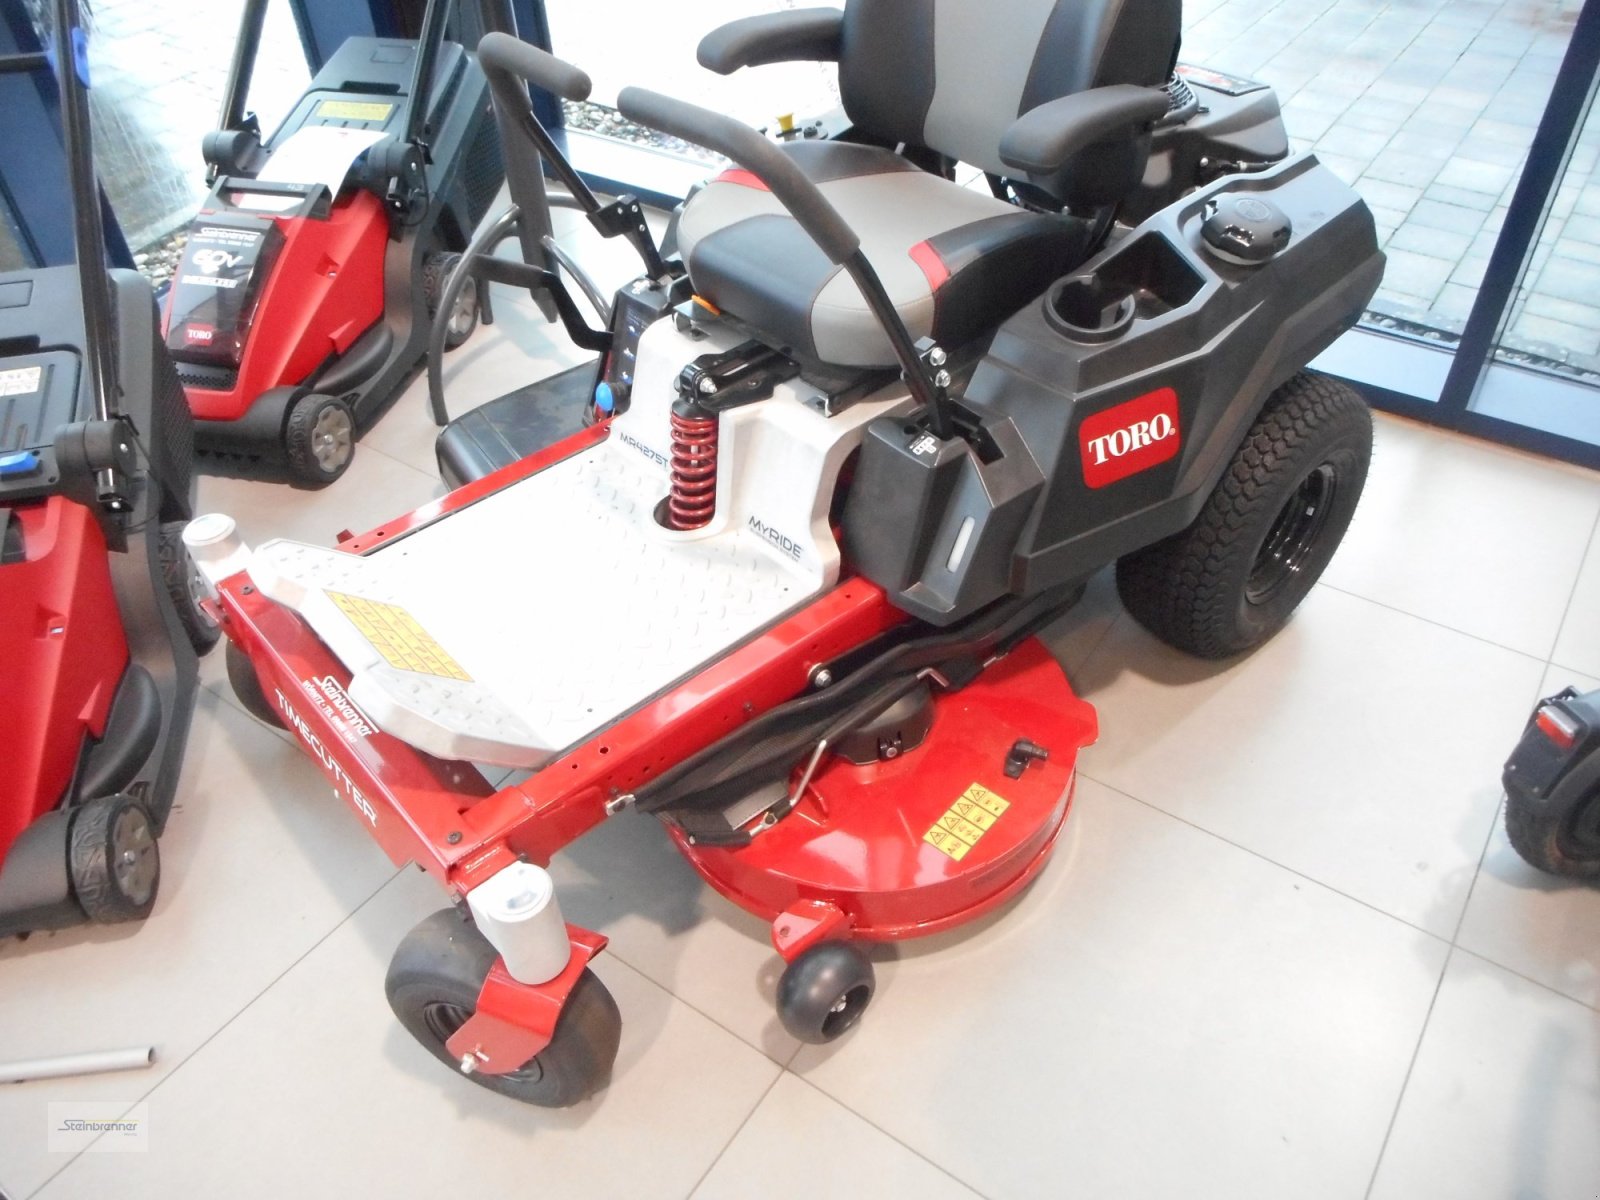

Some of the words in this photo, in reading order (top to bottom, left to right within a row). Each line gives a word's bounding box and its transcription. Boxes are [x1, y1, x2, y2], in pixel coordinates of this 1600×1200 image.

[187, 329, 212, 340] TORO
[620, 432, 669, 468] MR4275T
[1087, 413, 1171, 466] TORO
[312, 675, 379, 737] Steinbrenner
[275, 688, 377, 828] TIMECUTTER
